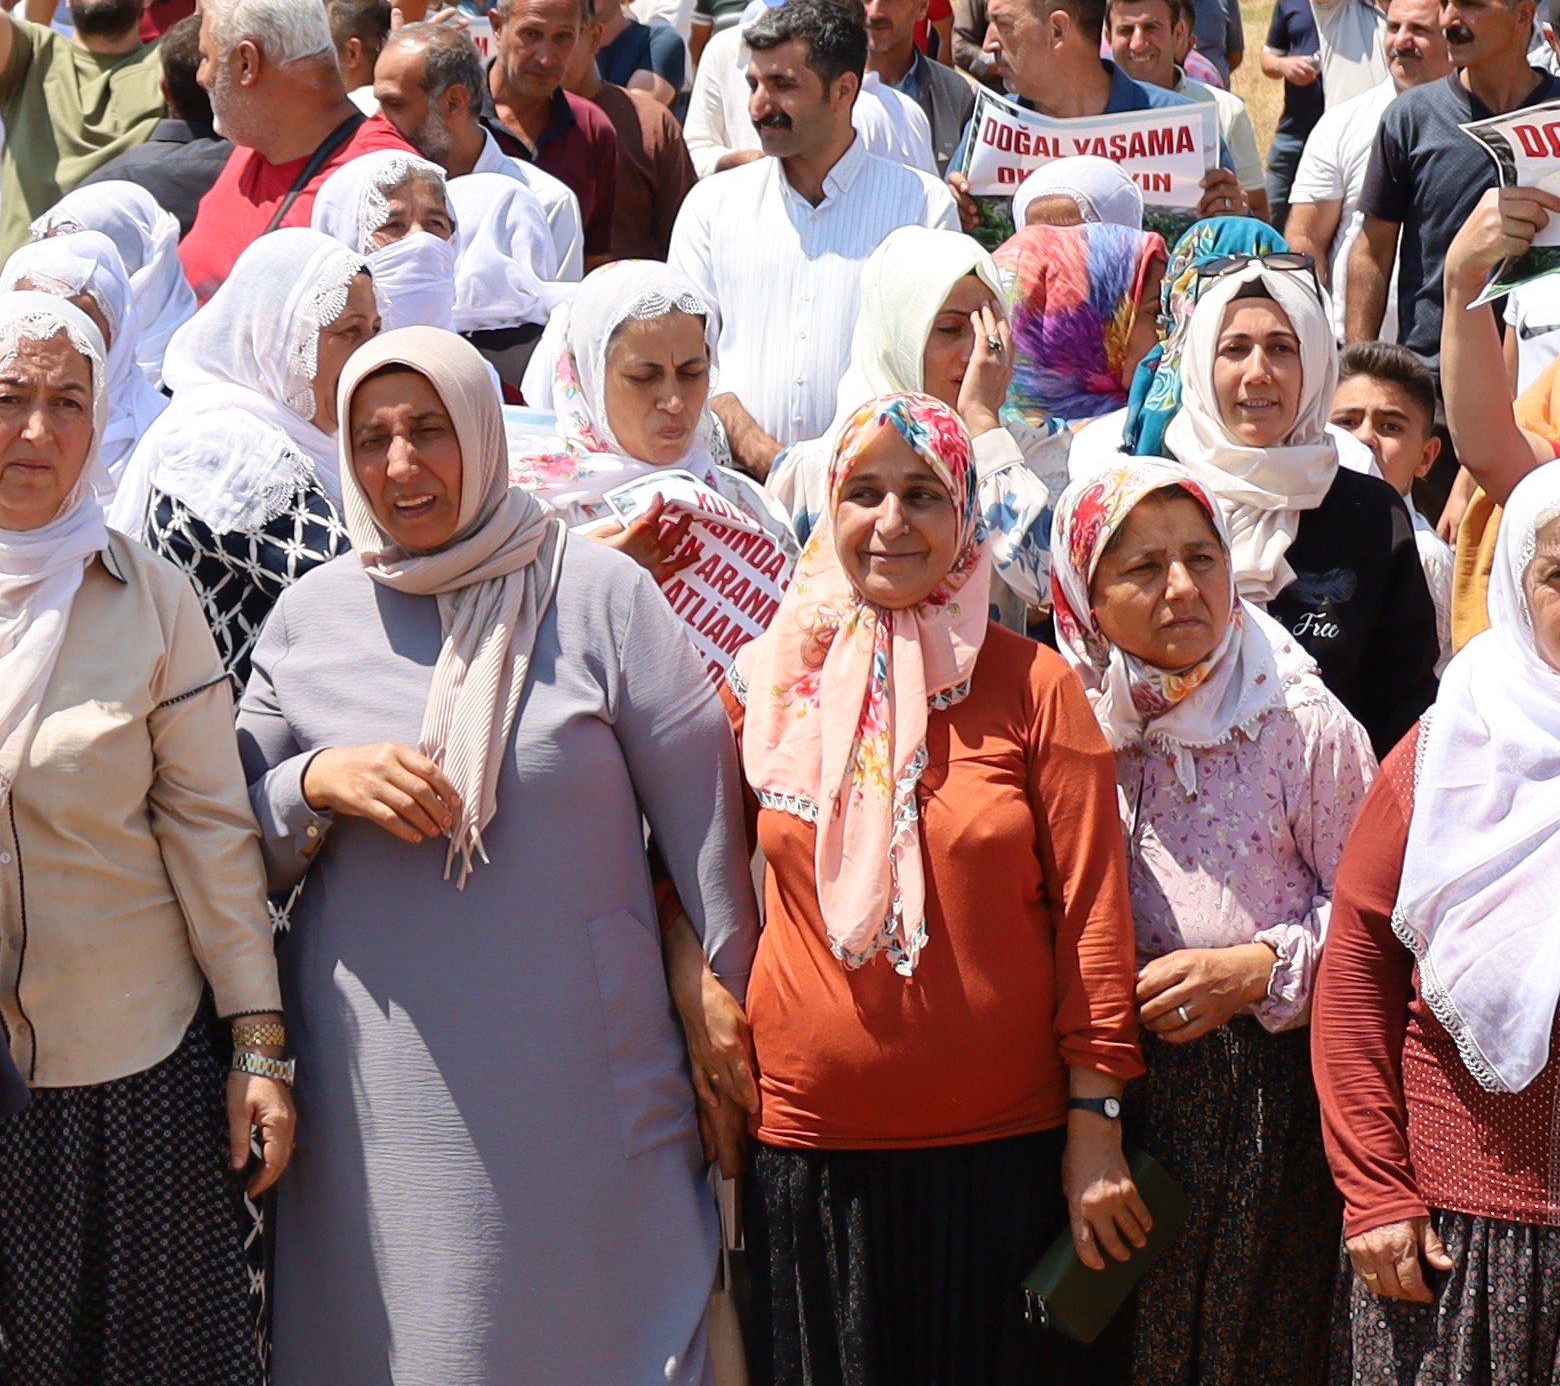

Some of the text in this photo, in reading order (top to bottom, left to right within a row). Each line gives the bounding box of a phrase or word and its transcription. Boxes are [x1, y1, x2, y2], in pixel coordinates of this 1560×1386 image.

[982, 116, 1195, 163] DOĞAL YAŞAMA
[1292, 611, 1340, 639] Free
